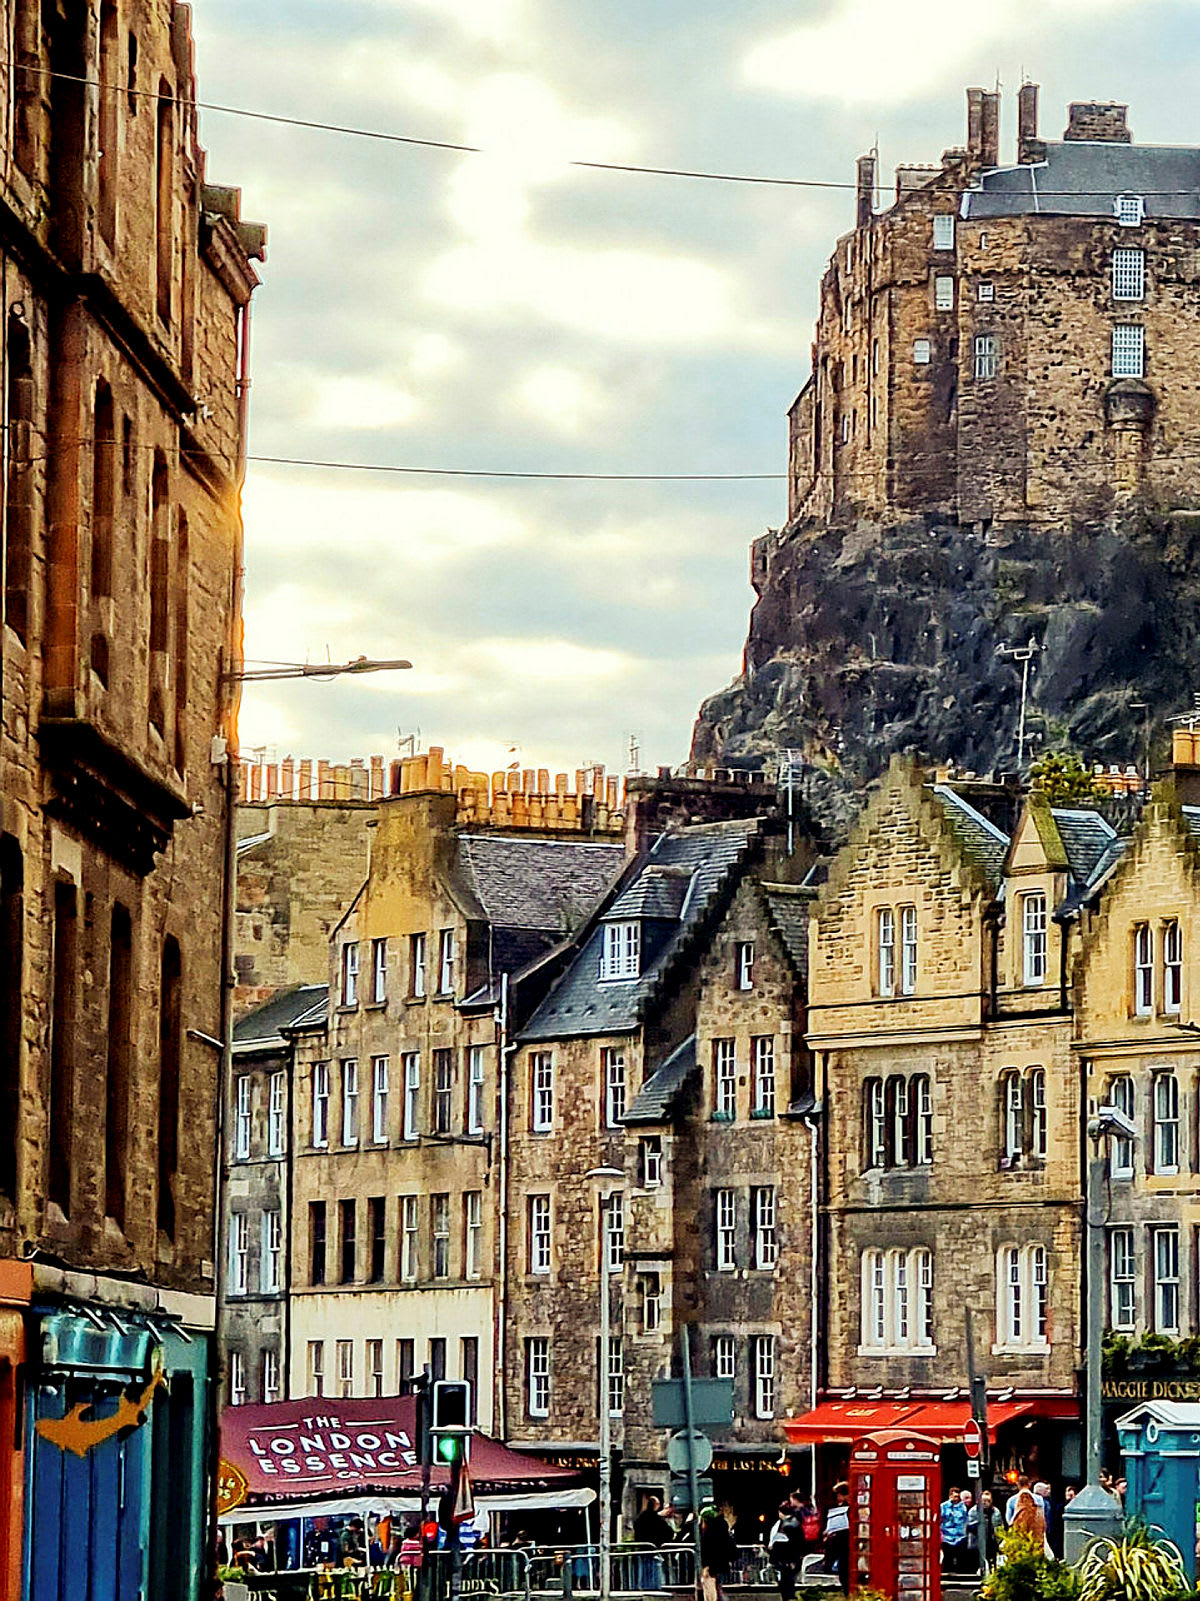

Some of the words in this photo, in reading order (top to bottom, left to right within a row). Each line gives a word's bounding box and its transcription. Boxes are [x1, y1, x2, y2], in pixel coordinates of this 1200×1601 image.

[1101, 1381, 1148, 1398] MAGGIE
[303, 1416, 341, 1430] THE
[249, 1431, 411, 1456] LONDON
[258, 1451, 417, 1474] ESSENCE
